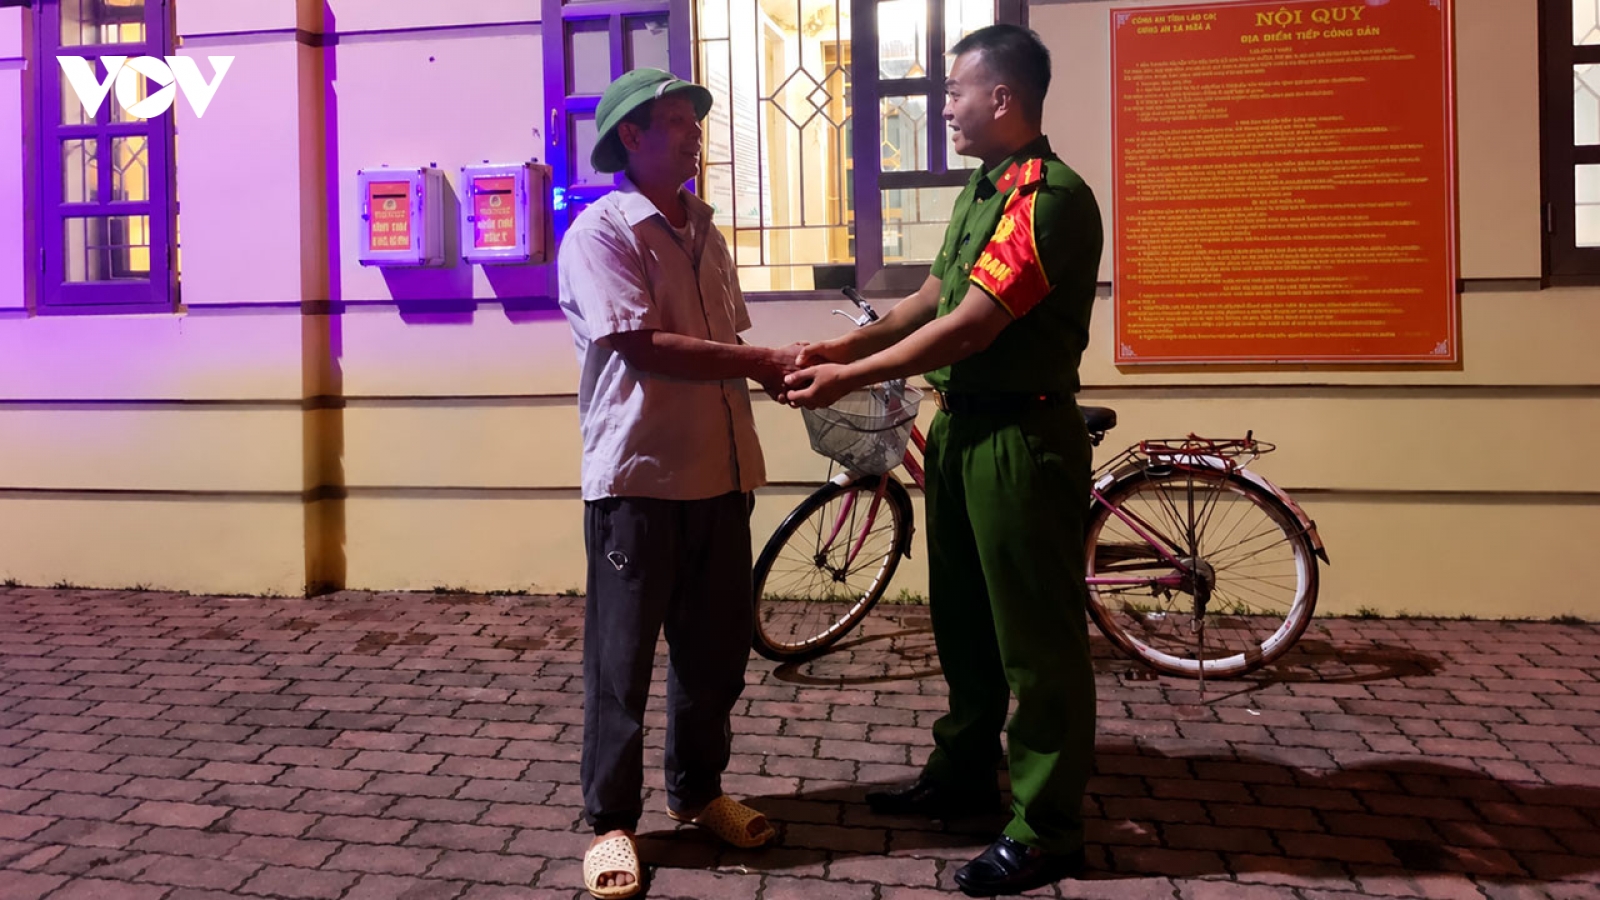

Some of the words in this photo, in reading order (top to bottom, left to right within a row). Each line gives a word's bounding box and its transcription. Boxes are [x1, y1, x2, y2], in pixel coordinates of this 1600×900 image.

[1255, 6, 1303, 28] NỘI
[1311, 5, 1365, 24] QUY
[1296, 29, 1320, 40] TIẾP
[1323, 27, 1353, 38] CÔNG
[1356, 25, 1380, 36] DÂN
